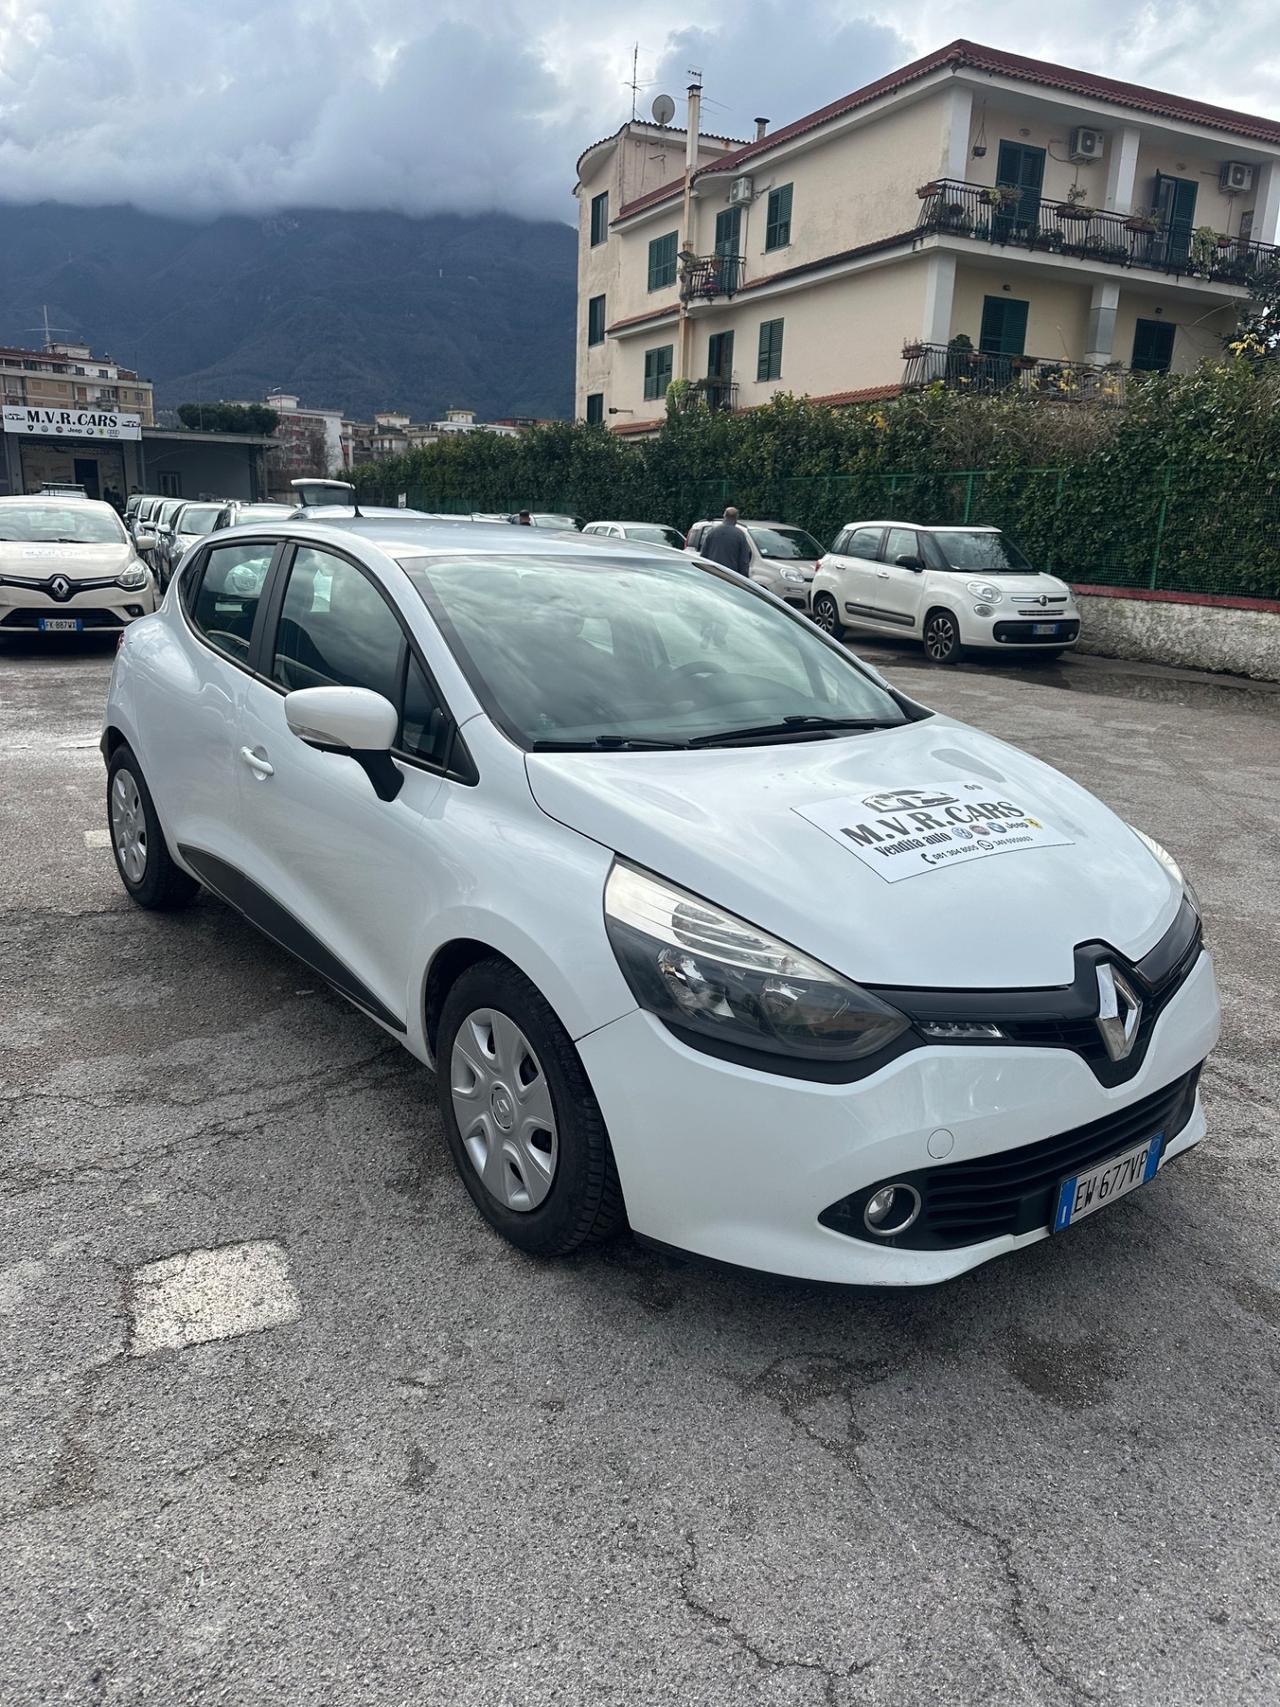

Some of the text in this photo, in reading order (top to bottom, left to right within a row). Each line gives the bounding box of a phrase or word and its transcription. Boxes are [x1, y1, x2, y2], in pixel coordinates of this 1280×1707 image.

[840, 801, 1025, 847] M.V.R.CARS
[873, 831, 953, 857] Vendita auto
[1074, 1176, 1097, 1213] EW
